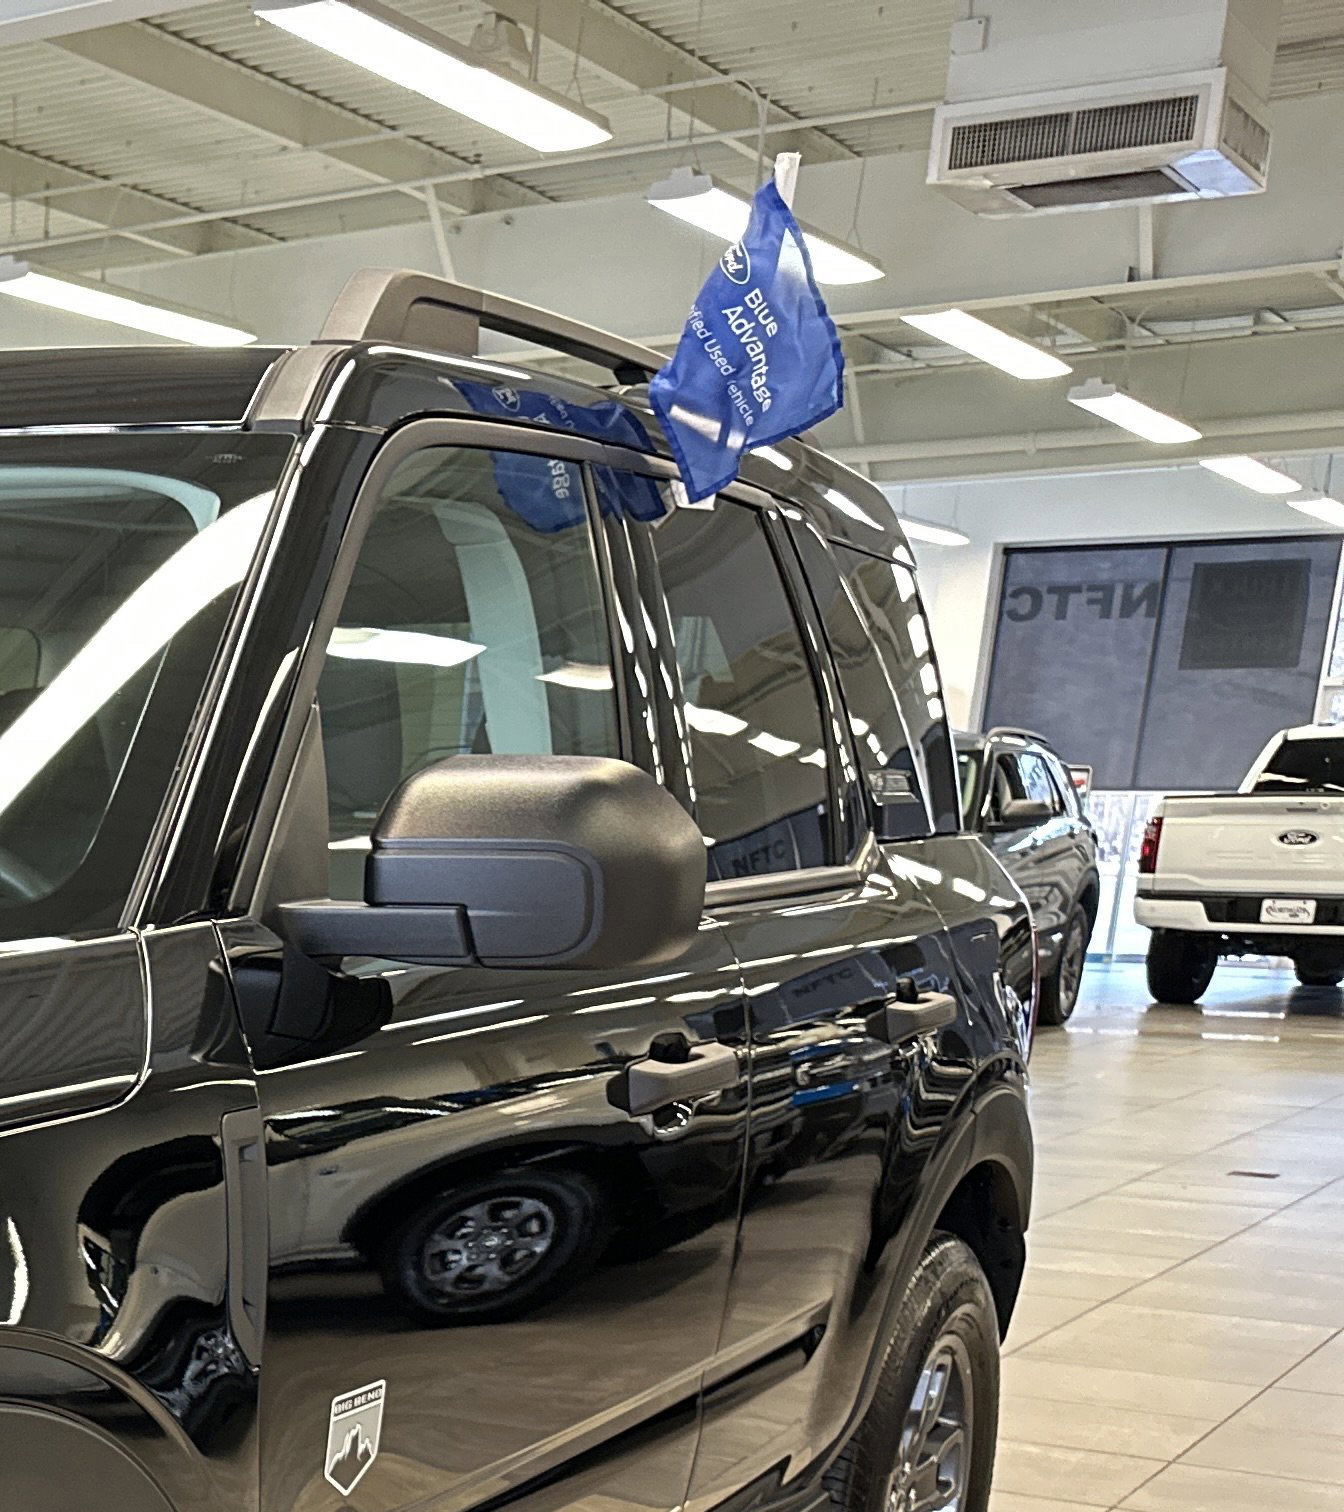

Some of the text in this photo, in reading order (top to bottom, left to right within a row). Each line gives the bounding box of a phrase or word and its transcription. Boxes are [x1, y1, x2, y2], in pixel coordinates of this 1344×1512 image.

[744, 287, 778, 338] Blue
[704, 338, 736, 377] Used
[721, 305, 772, 413] Advantage
[334, 1387, 382, 1414] BIG BEND
